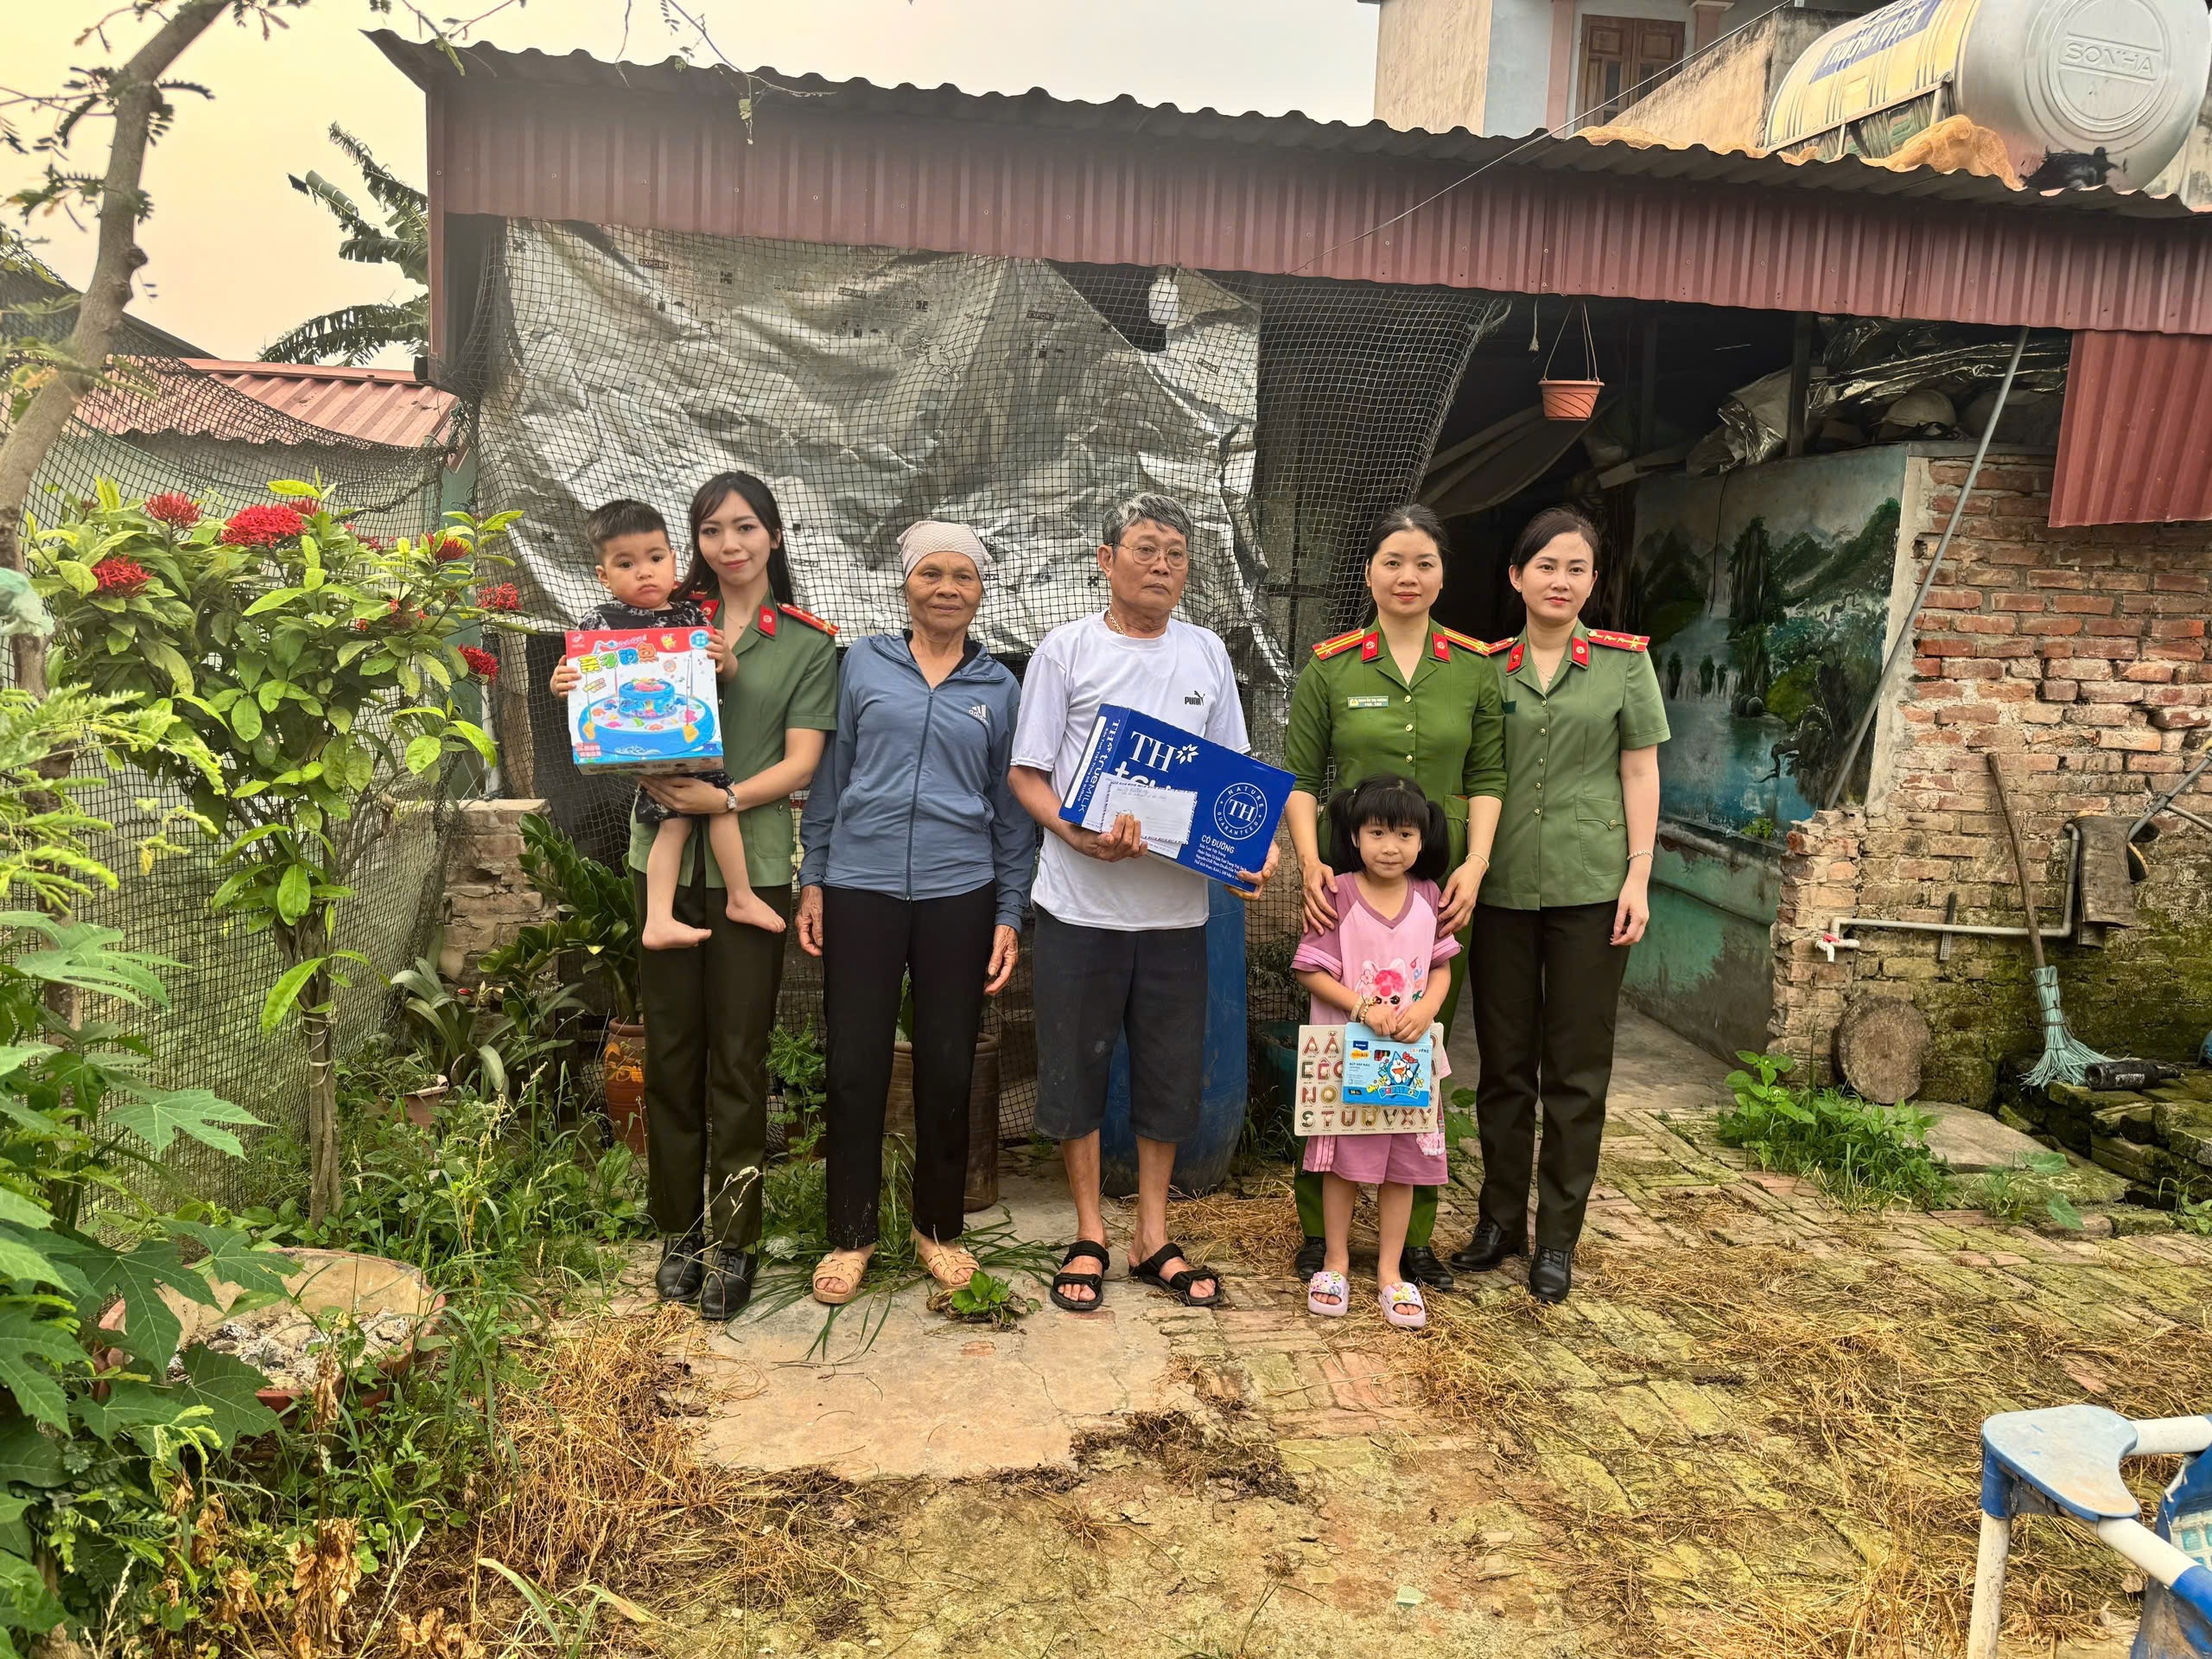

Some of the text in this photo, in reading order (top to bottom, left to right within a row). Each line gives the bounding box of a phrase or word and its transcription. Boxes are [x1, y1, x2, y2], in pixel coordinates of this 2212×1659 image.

[639, 259, 669, 270] EXPORT
[1027, 312, 1054, 321] EXPORT
[1128, 730, 1178, 773] TH
[1228, 785, 1264, 808] NATURE
[1228, 798, 1257, 823] TH
[1217, 811, 1259, 836] GUARANTEED
[1201, 834, 1236, 854] CÓ ĐƯỜNG
[1303, 1037, 1319, 1053] A
[1302, 1086, 1316, 1103] N
[1302, 1110, 1314, 1128] S
[1321, 1110, 1334, 1127] T
[1383, 1109, 1397, 1126] V
[1401, 1109, 1415, 1125] X
[1418, 1109, 1432, 1124] Y
